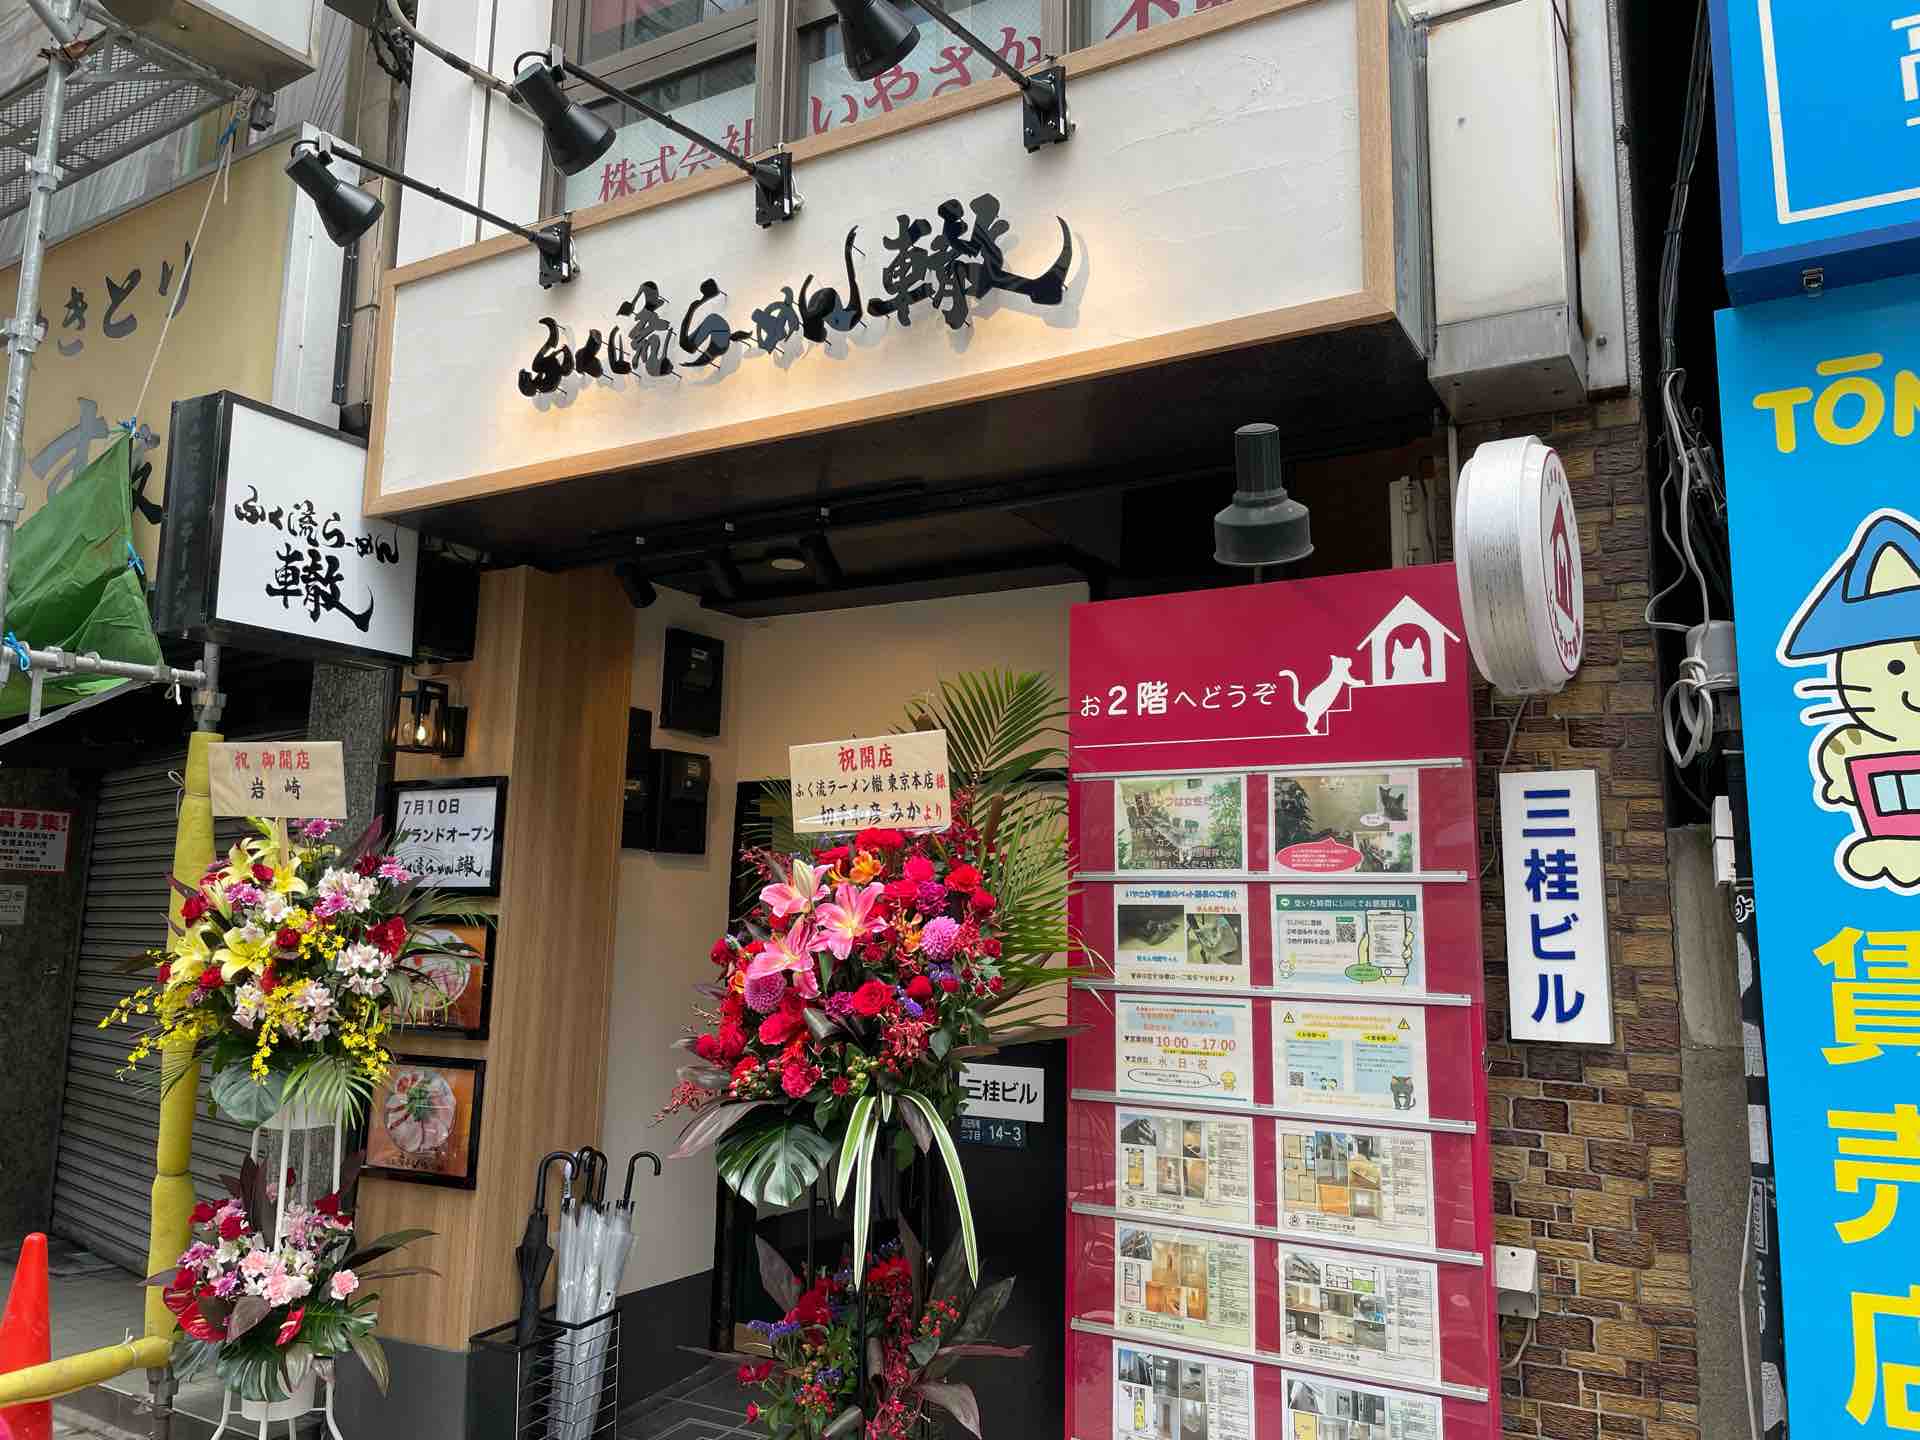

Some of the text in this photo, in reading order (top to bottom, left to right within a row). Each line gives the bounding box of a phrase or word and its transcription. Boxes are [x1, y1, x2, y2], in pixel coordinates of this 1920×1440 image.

[599, 118, 753, 202] 株式会社
[234, 484, 399, 564] ふく流らーめん
[1080, 681, 1277, 717] お2階へどうぞ
[839, 744, 893, 770] 祝開店
[403, 799, 460, 815] 7月10日
[402, 826, 493, 842] ランドオープン
[1522, 788, 1585, 1024] 三桂ビル
[967, 1078, 1038, 1105] 三桂ビル
